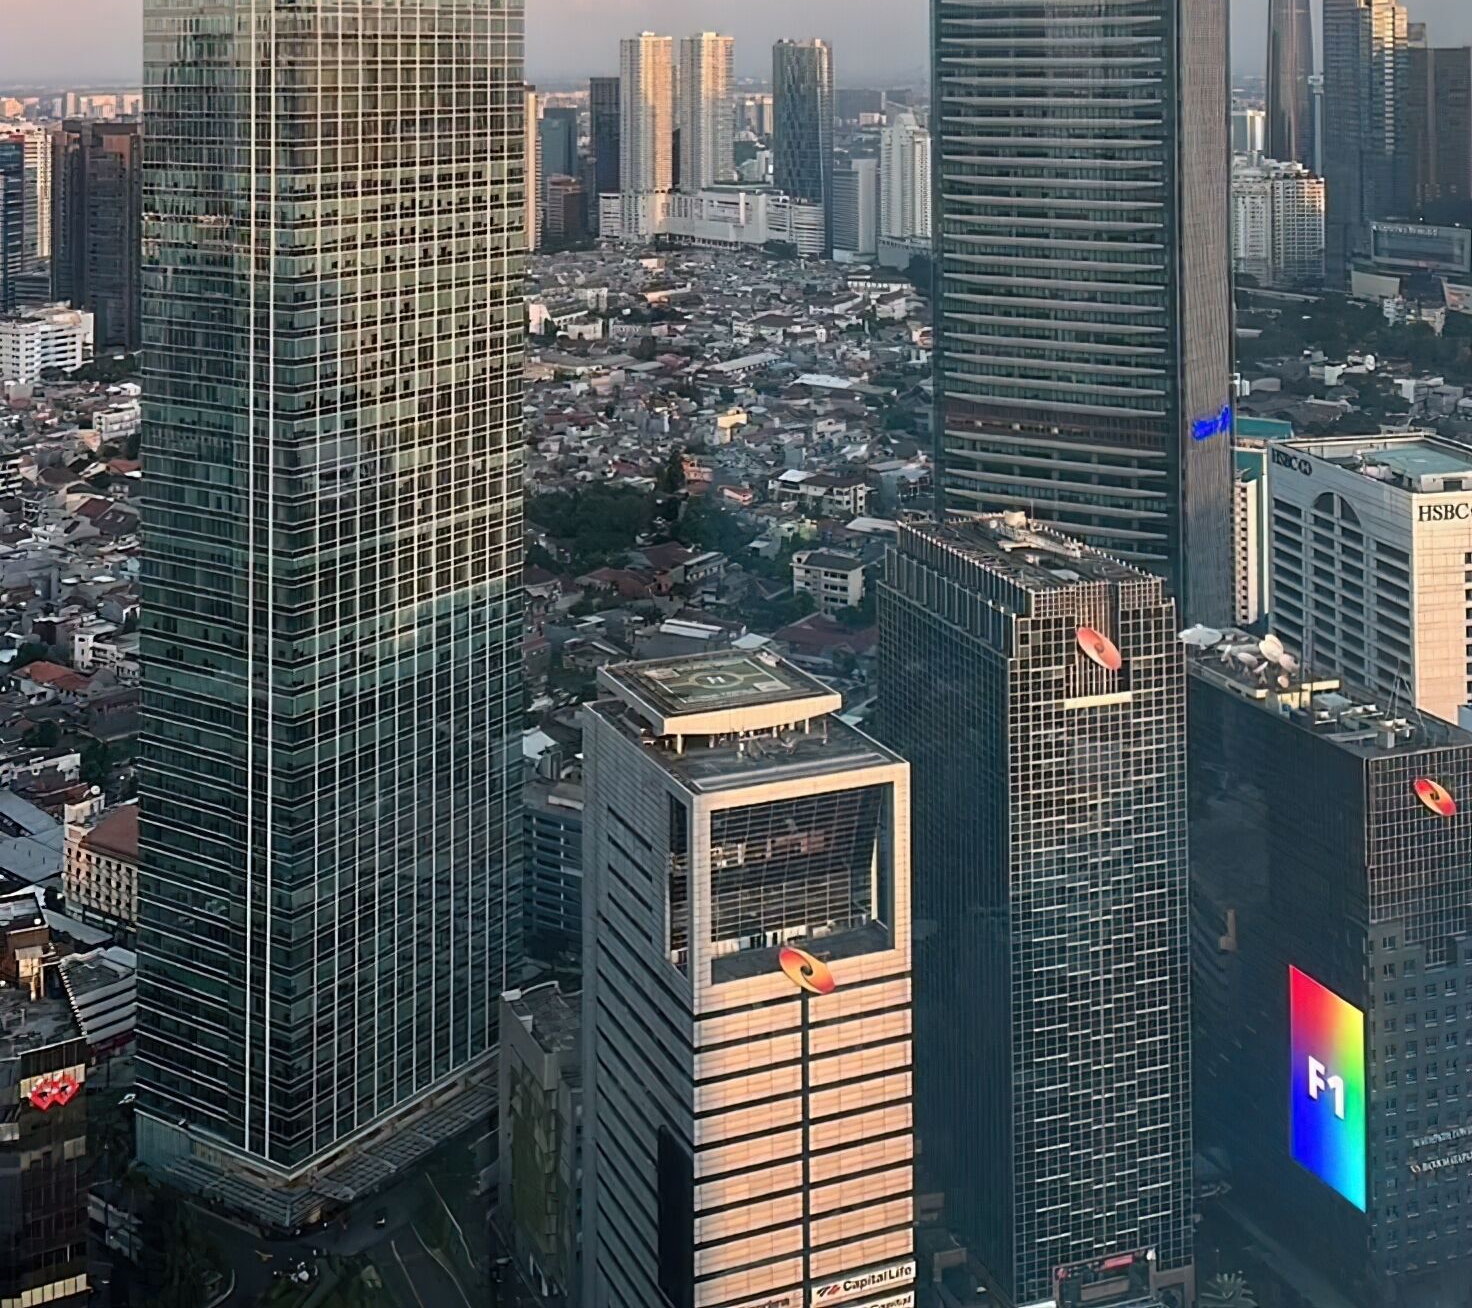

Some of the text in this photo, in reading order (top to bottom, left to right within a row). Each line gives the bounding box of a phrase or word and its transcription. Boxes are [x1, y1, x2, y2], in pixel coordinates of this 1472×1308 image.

[1418, 503, 1470, 522] HSBC
[1308, 1055, 1344, 1120] F1
[843, 1271, 887, 1291] Capital
